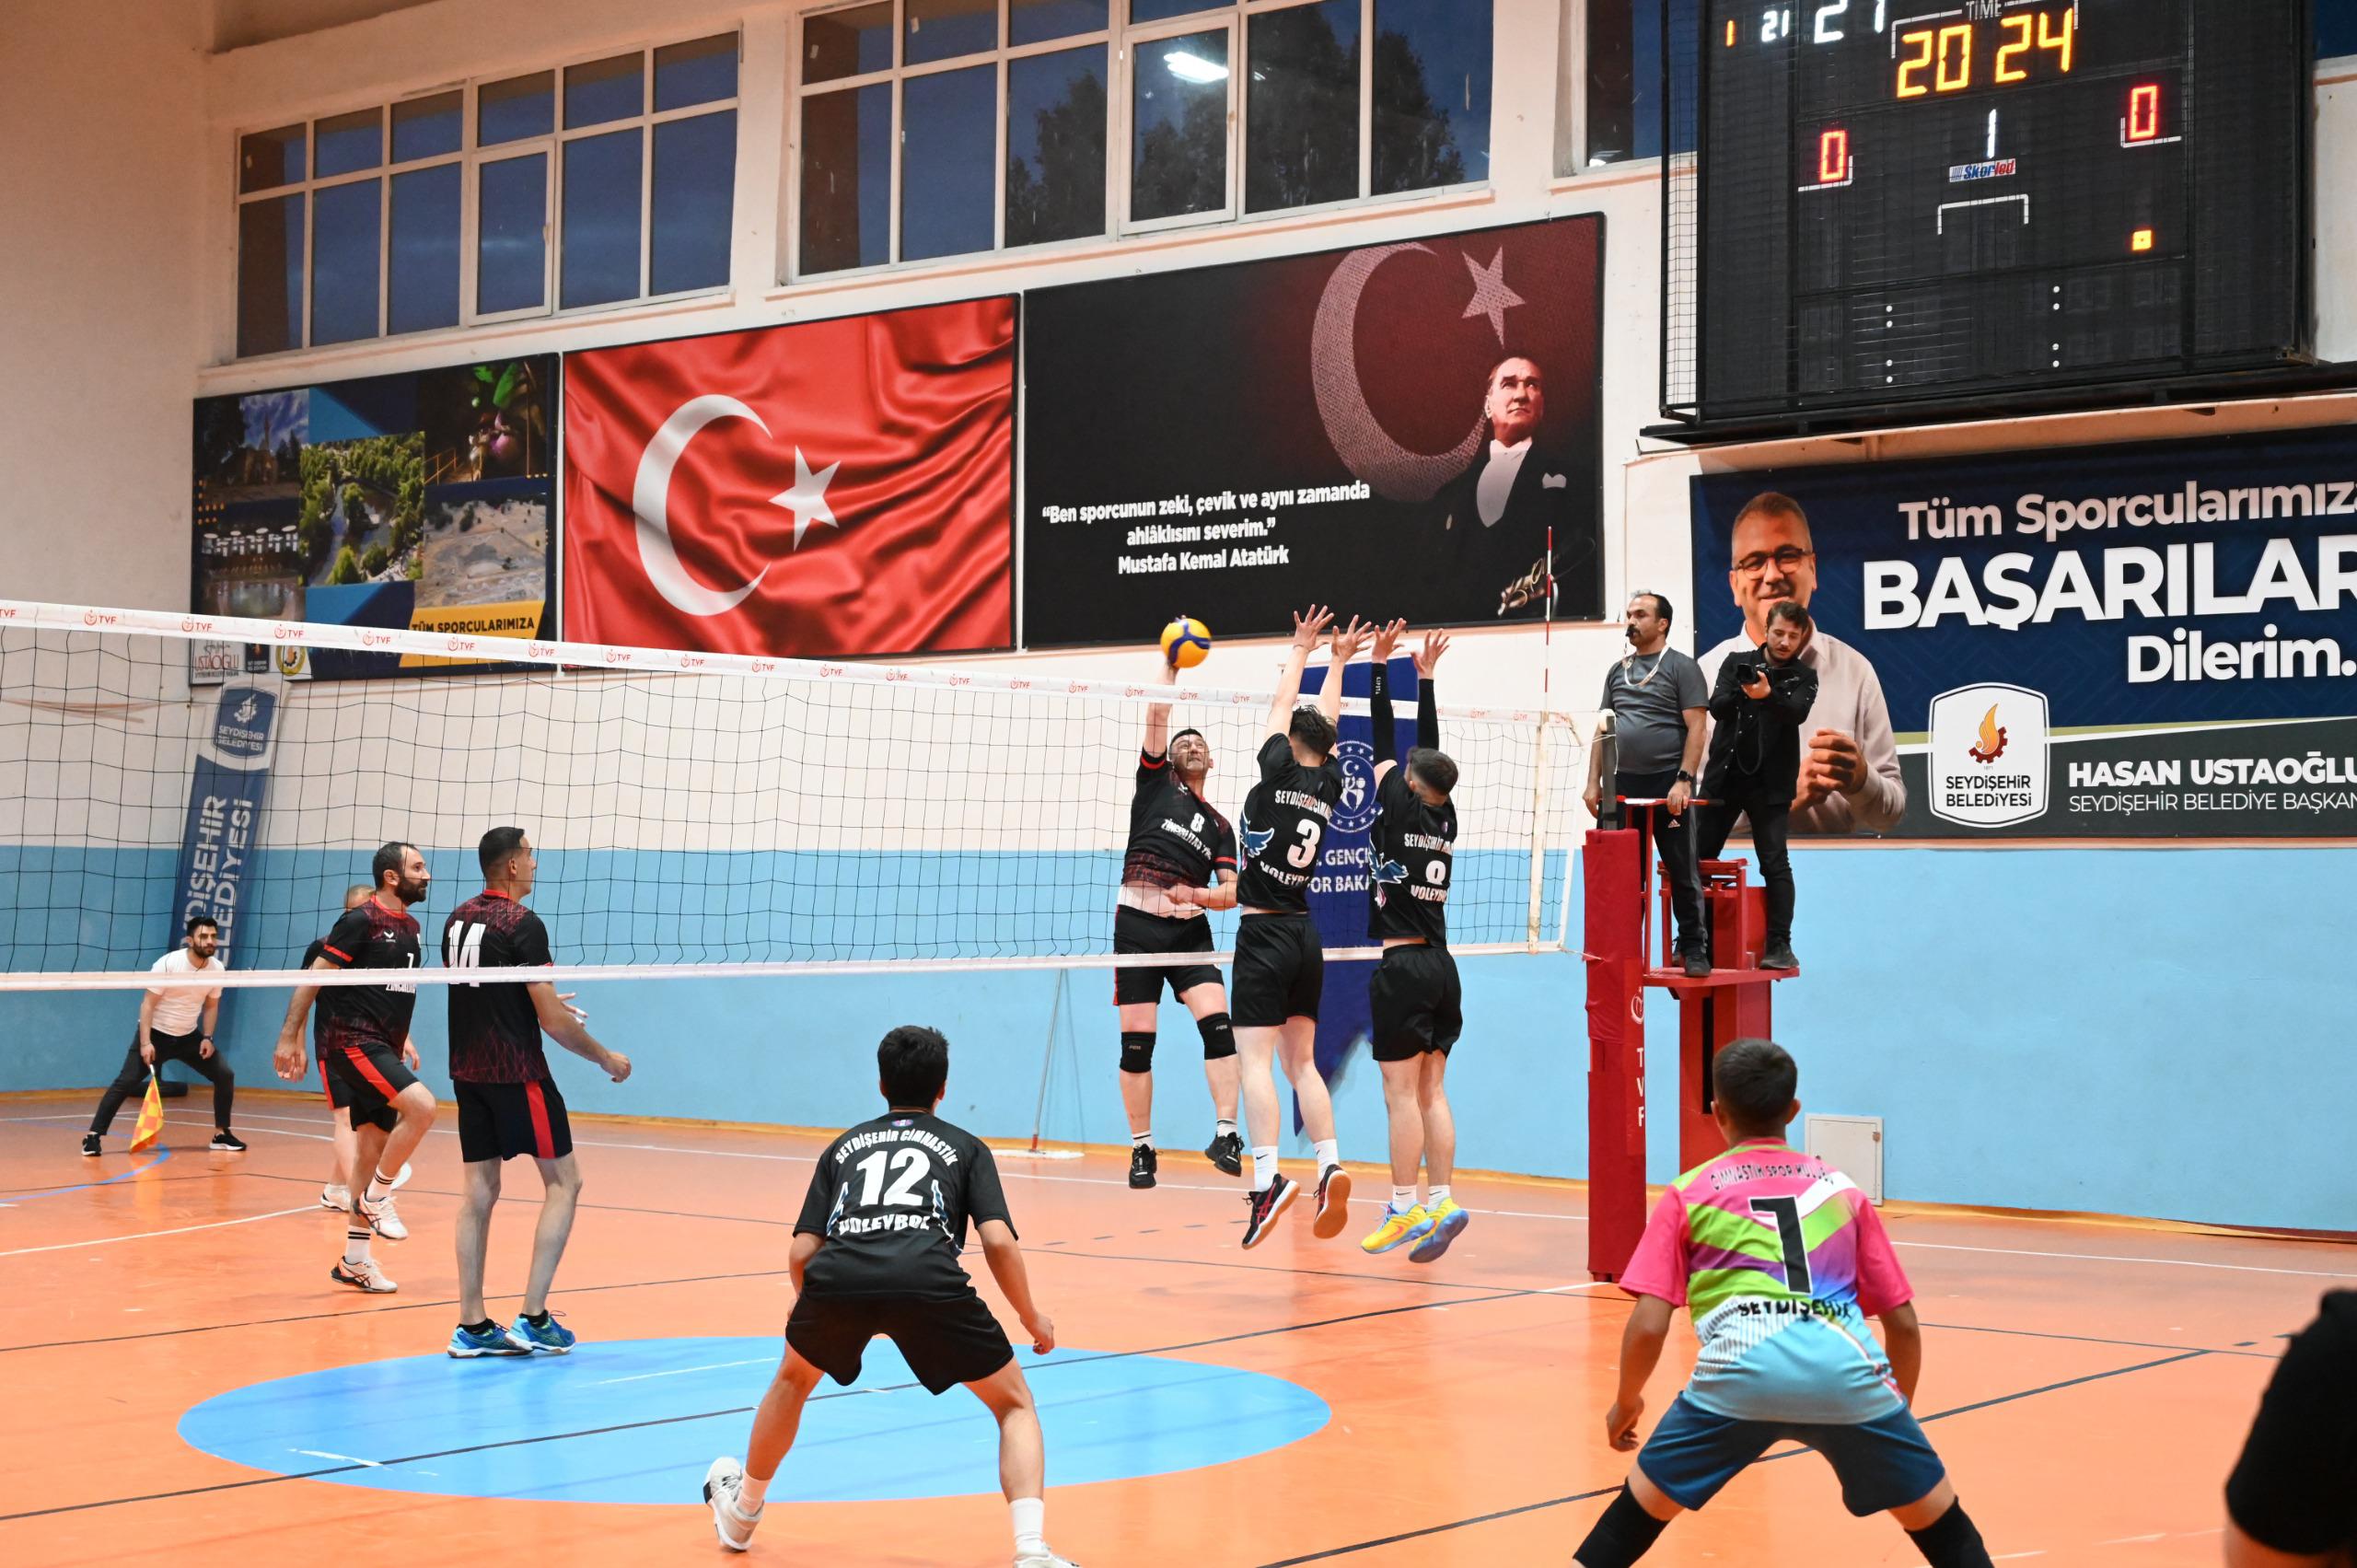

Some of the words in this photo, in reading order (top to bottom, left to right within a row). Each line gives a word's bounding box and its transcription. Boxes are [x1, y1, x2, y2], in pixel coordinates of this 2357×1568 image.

[1967, 0, 2003, 20] TIME
[1761, 9, 1790, 42] 21
[1897, 24, 1972, 98] 20
[1995, 7, 2073, 83] 24
[2129, 85, 2158, 140] 0
[1987, 109, 1997, 159] 1
[1819, 130, 1847, 183] 0
[1963, 160, 2016, 180] Skorled
[1079, 498, 1155, 525] sporcunun
[1158, 494, 1193, 517] zeki,
[1196, 491, 1237, 516] çevik
[1239, 494, 1259, 509] ve
[1261, 490, 1295, 512] aynı
[1296, 480, 1371, 504] zamanda
[1898, 497, 2003, 540] Tüm
[2015, 481, 2357, 542] Sporcularımız
[1127, 525, 1202, 546] ahlâklısını
[1118, 553, 1177, 575] Mustafa
[1179, 550, 1227, 571] Kemal
[1229, 544, 1290, 567] Atatürk
[1864, 535, 2357, 632] BAŞARILAR
[99, 615, 118, 625] TVF
[195, 622, 213, 633] TVF
[287, 629, 305, 638] TVF
[437, 617, 535, 633] SPORCULARIMIZA
[375, 635, 391, 645] TVF
[459, 642, 475, 651] TVF
[540, 648, 555, 656] TVF
[2127, 622, 2357, 683] Dilerim.
[617, 654, 632, 662] TVF
[691, 658, 705, 667] TVF
[762, 663, 775, 671] TVF
[1946, 774, 2031, 791] SEYDİŞEHİR
[2069, 760, 2181, 787] HASAN
[1945, 793, 2032, 807] BELEDİYESİ
[2069, 790, 2178, 816] SEYDİŞEHİR
[2183, 789, 2278, 811] BELEDİYE
[1190, 812, 1205, 833] 8
[1286, 819, 1321, 868] 3
[448, 921, 487, 988] 14
[835, 1129, 899, 1165] SEYDİŞEHİR
[900, 1128, 958, 1167] CİMNASTİK
[856, 1147, 931, 1207] 12
[1748, 1195, 1813, 1295] 1
